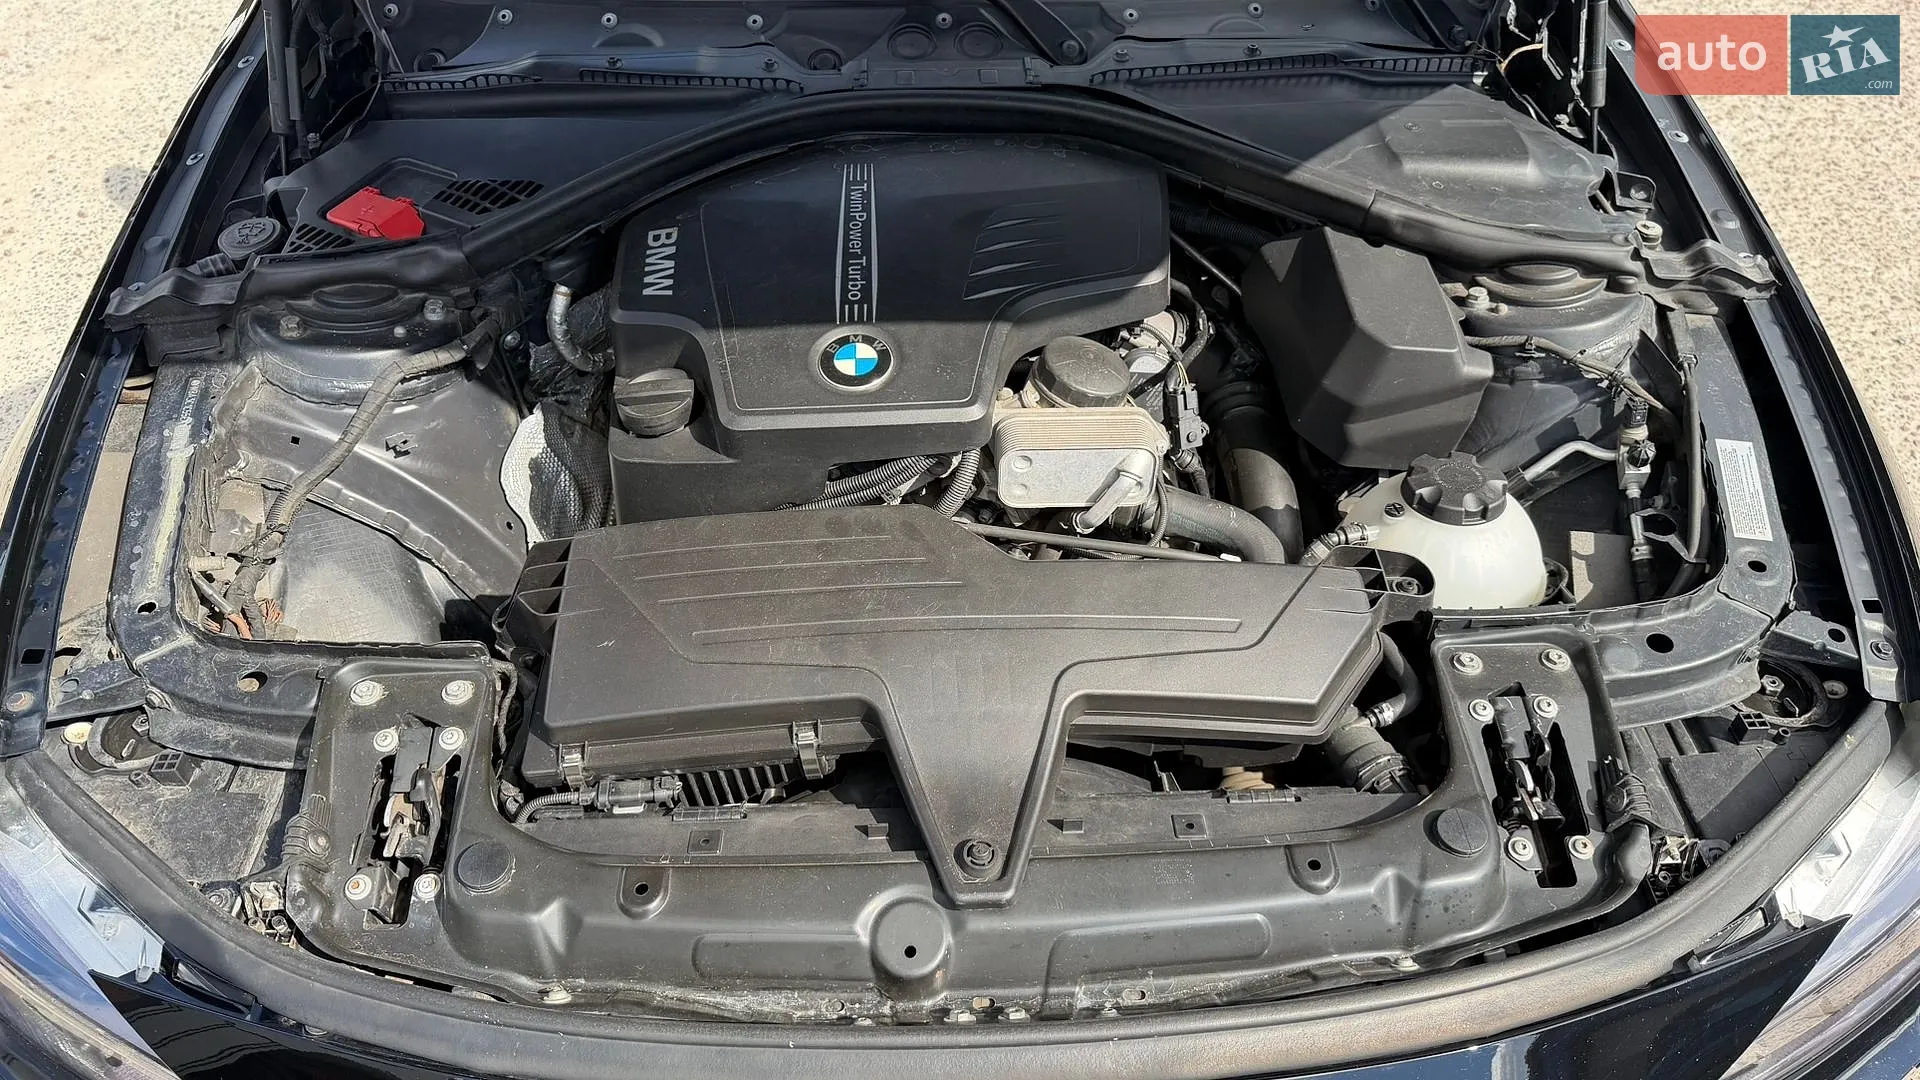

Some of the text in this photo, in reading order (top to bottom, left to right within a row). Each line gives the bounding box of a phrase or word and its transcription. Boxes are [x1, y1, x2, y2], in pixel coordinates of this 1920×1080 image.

[642, 227, 679, 295] BMW
[848, 183, 867, 300] TwinPower Turbo
[826, 335, 887, 354] BMW
